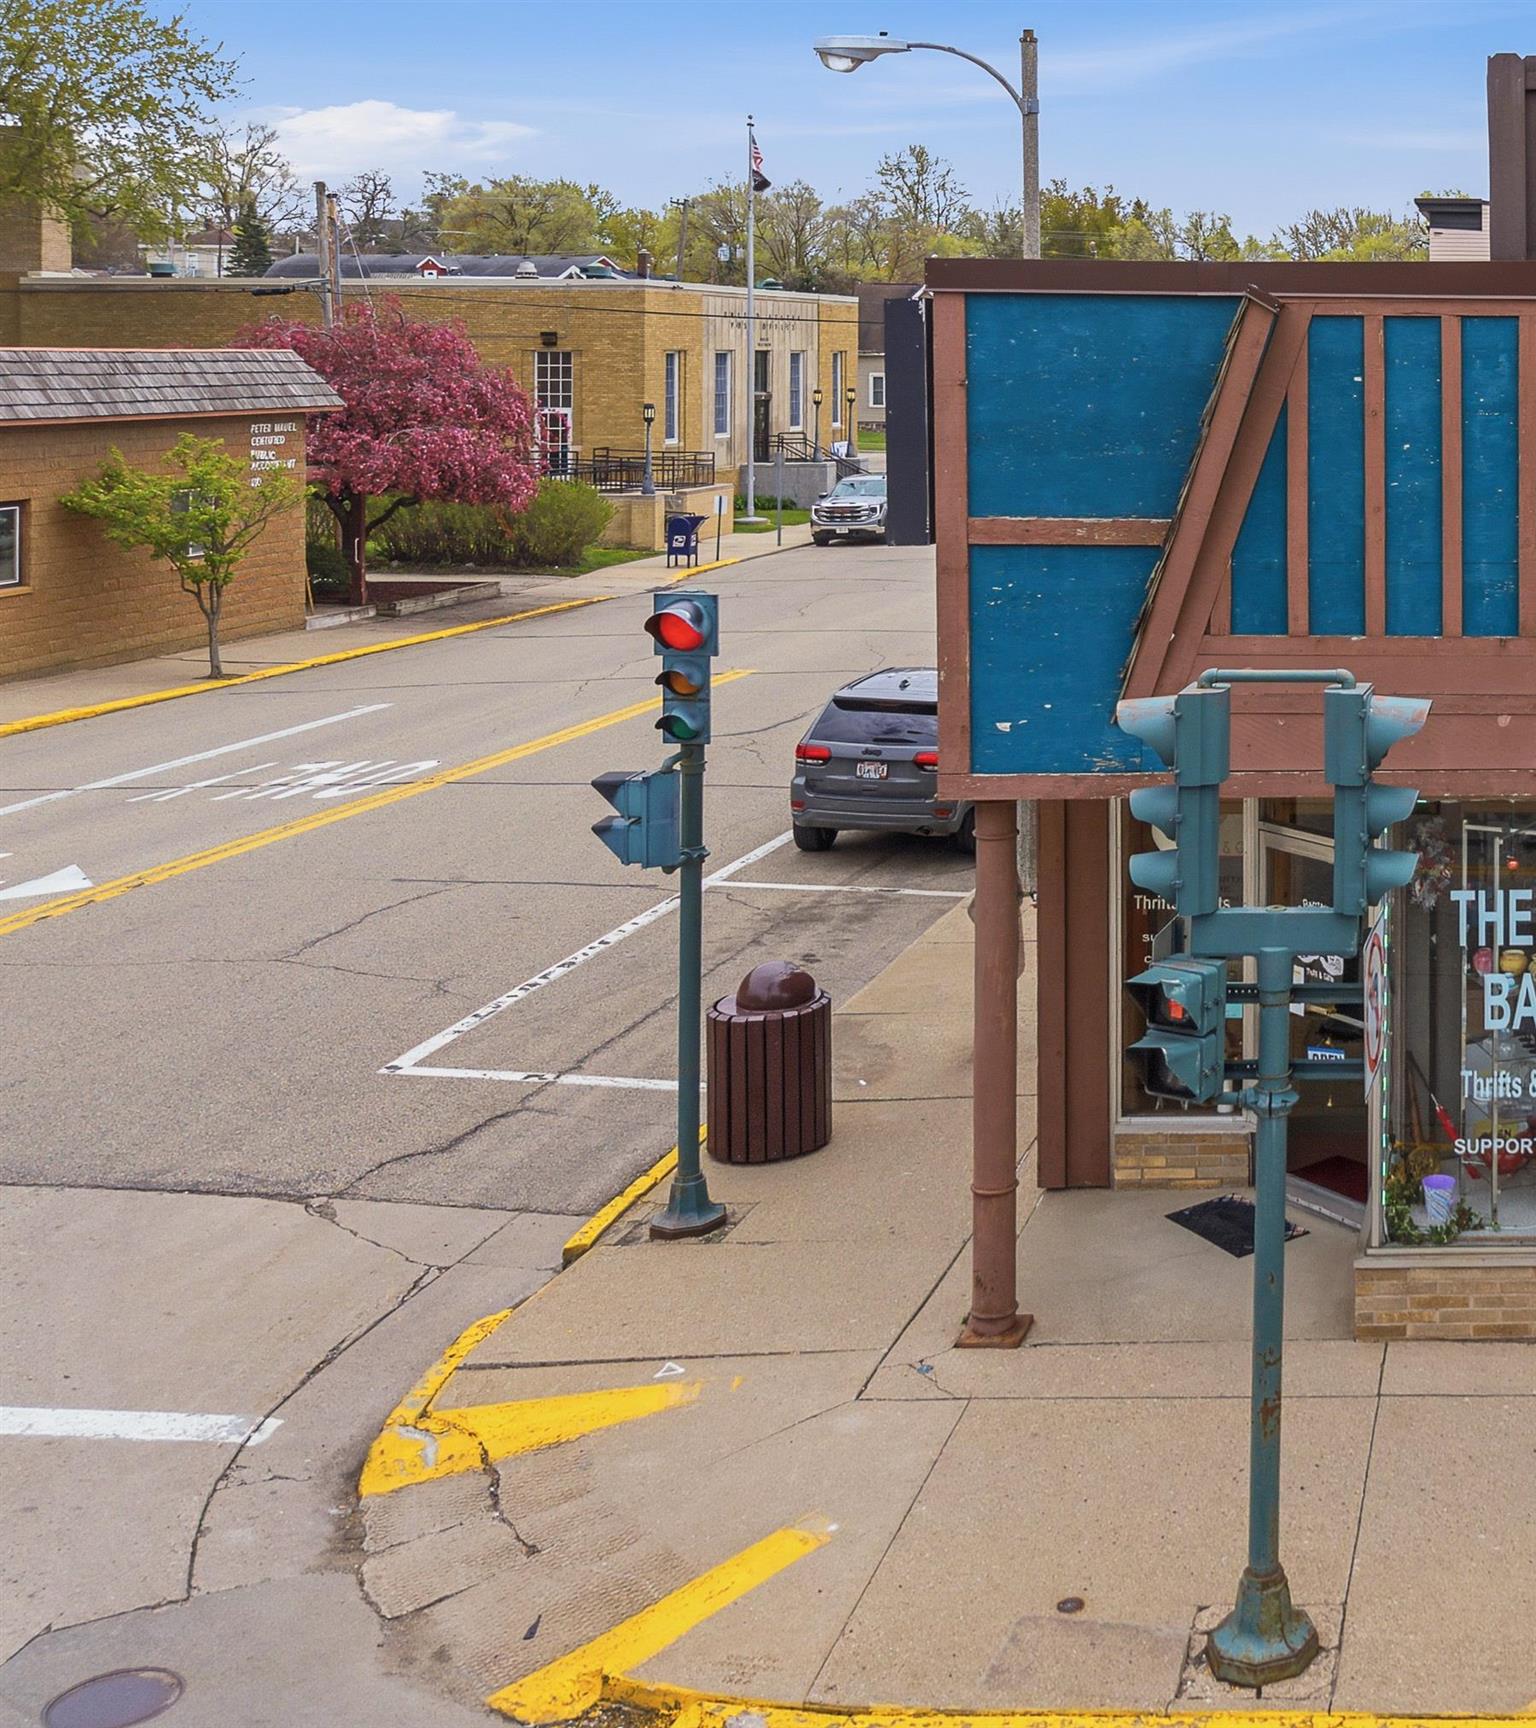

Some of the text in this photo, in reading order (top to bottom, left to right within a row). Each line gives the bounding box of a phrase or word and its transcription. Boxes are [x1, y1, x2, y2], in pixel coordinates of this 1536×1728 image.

[251, 424, 271, 433] PETER
[1450, 889, 1534, 947] THE
[1461, 1069, 1522, 1098] Thrifts
